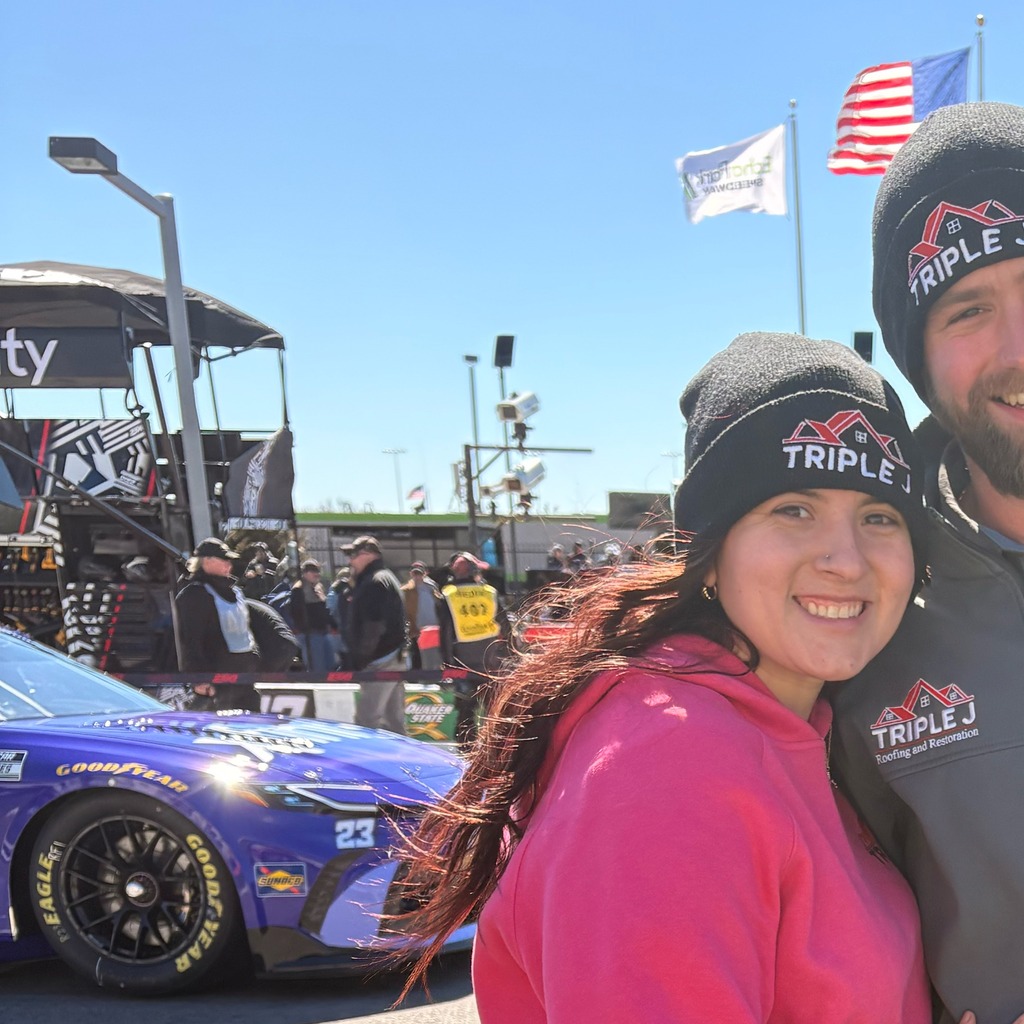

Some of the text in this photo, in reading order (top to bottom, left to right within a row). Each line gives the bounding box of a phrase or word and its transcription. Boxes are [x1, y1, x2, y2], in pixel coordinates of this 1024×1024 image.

[910, 228, 1003, 306] TRIPLE
[782, 444, 911, 494] TRIPLE J
[404, 702, 454, 715] QUAKER
[410, 714, 446, 723] STATE
[871, 701, 976, 749] TRIPLE J
[875, 728, 979, 765] Roofing and Restoration
[56, 762, 189, 793] GOODYEAR
[335, 817, 375, 850] 23
[37, 852, 61, 925] EAGLE
[257, 874, 305, 887] SUNOCO
[175, 833, 223, 973] GOODYEAR
